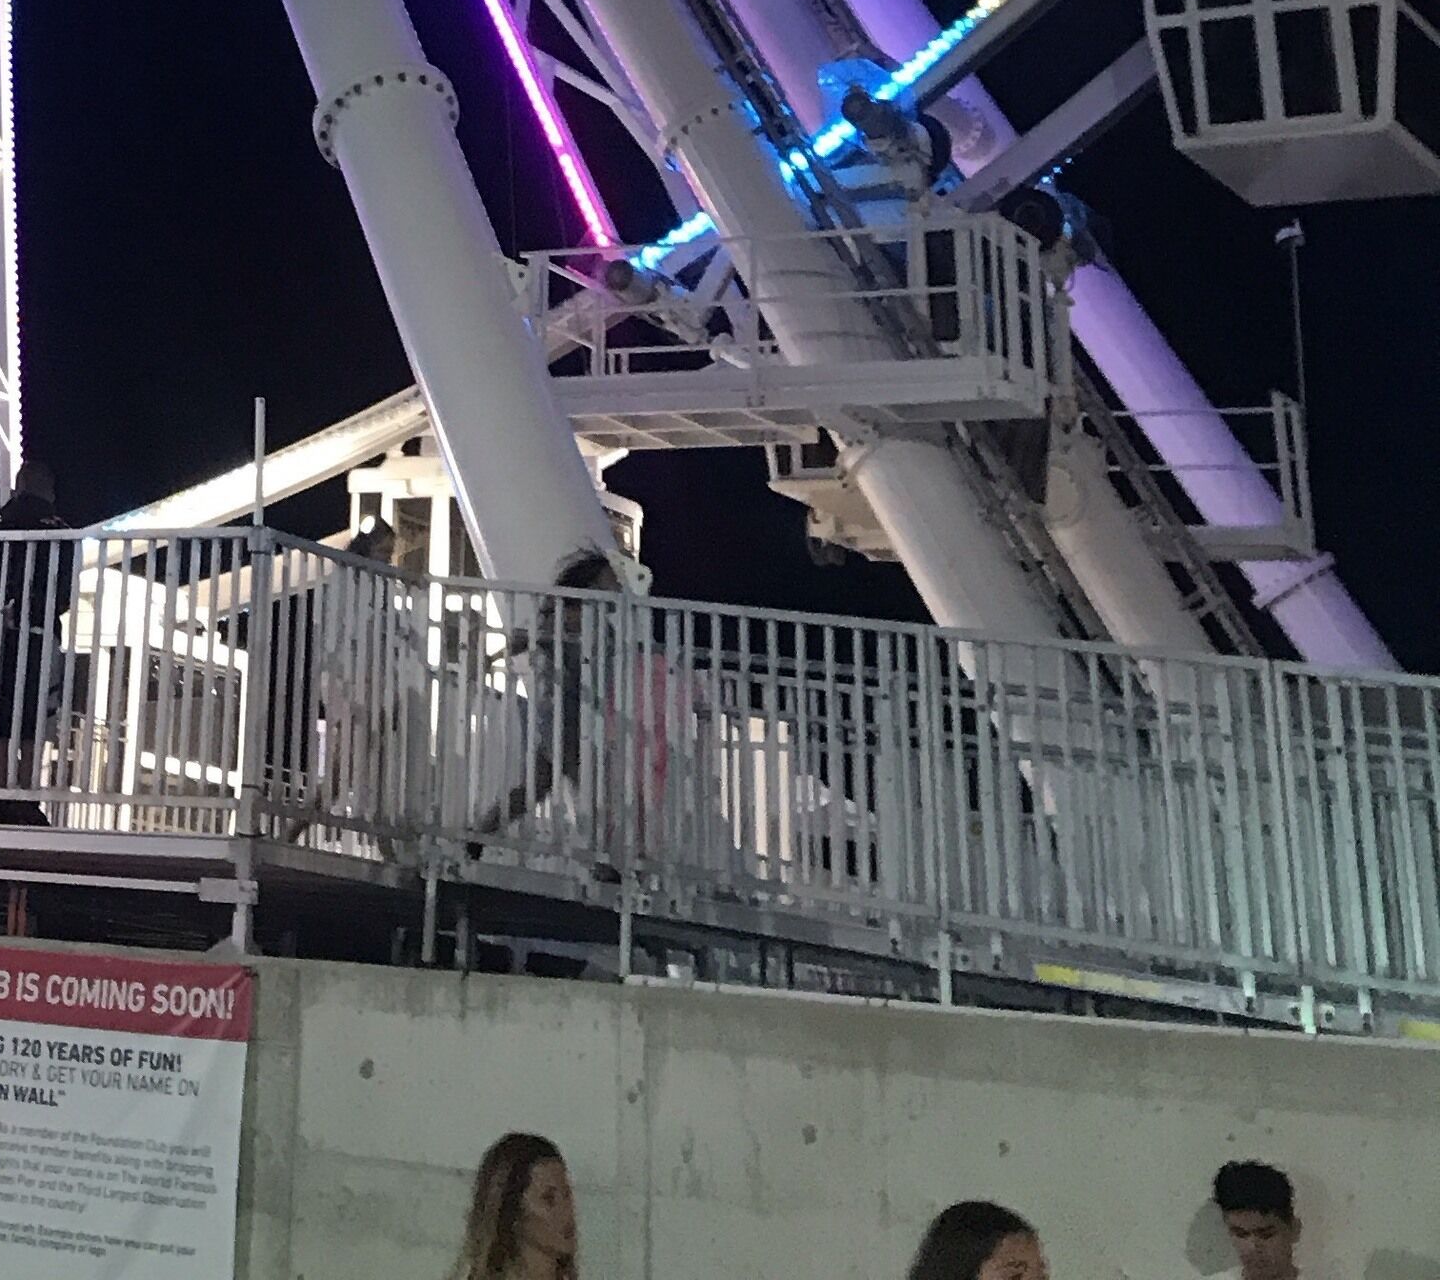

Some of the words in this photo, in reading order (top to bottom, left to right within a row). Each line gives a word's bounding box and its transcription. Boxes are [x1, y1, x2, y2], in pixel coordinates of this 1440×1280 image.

[16, 972, 40, 1002] IS
[46, 975, 145, 1013] COMING
[151, 984, 235, 1019] SOON!
[12, 1037, 41, 1059] 120
[47, 1041, 105, 1065] YEARS
[110, 1048, 133, 1068] OF
[138, 1051, 181, 1073] FUN!
[32, 1064, 41, 1080] &
[47, 1065, 76, 1084] GET
[81, 1069, 121, 1090] YOUR
[127, 1074, 173, 1094] NAME
[178, 1078, 200, 1097] ON
